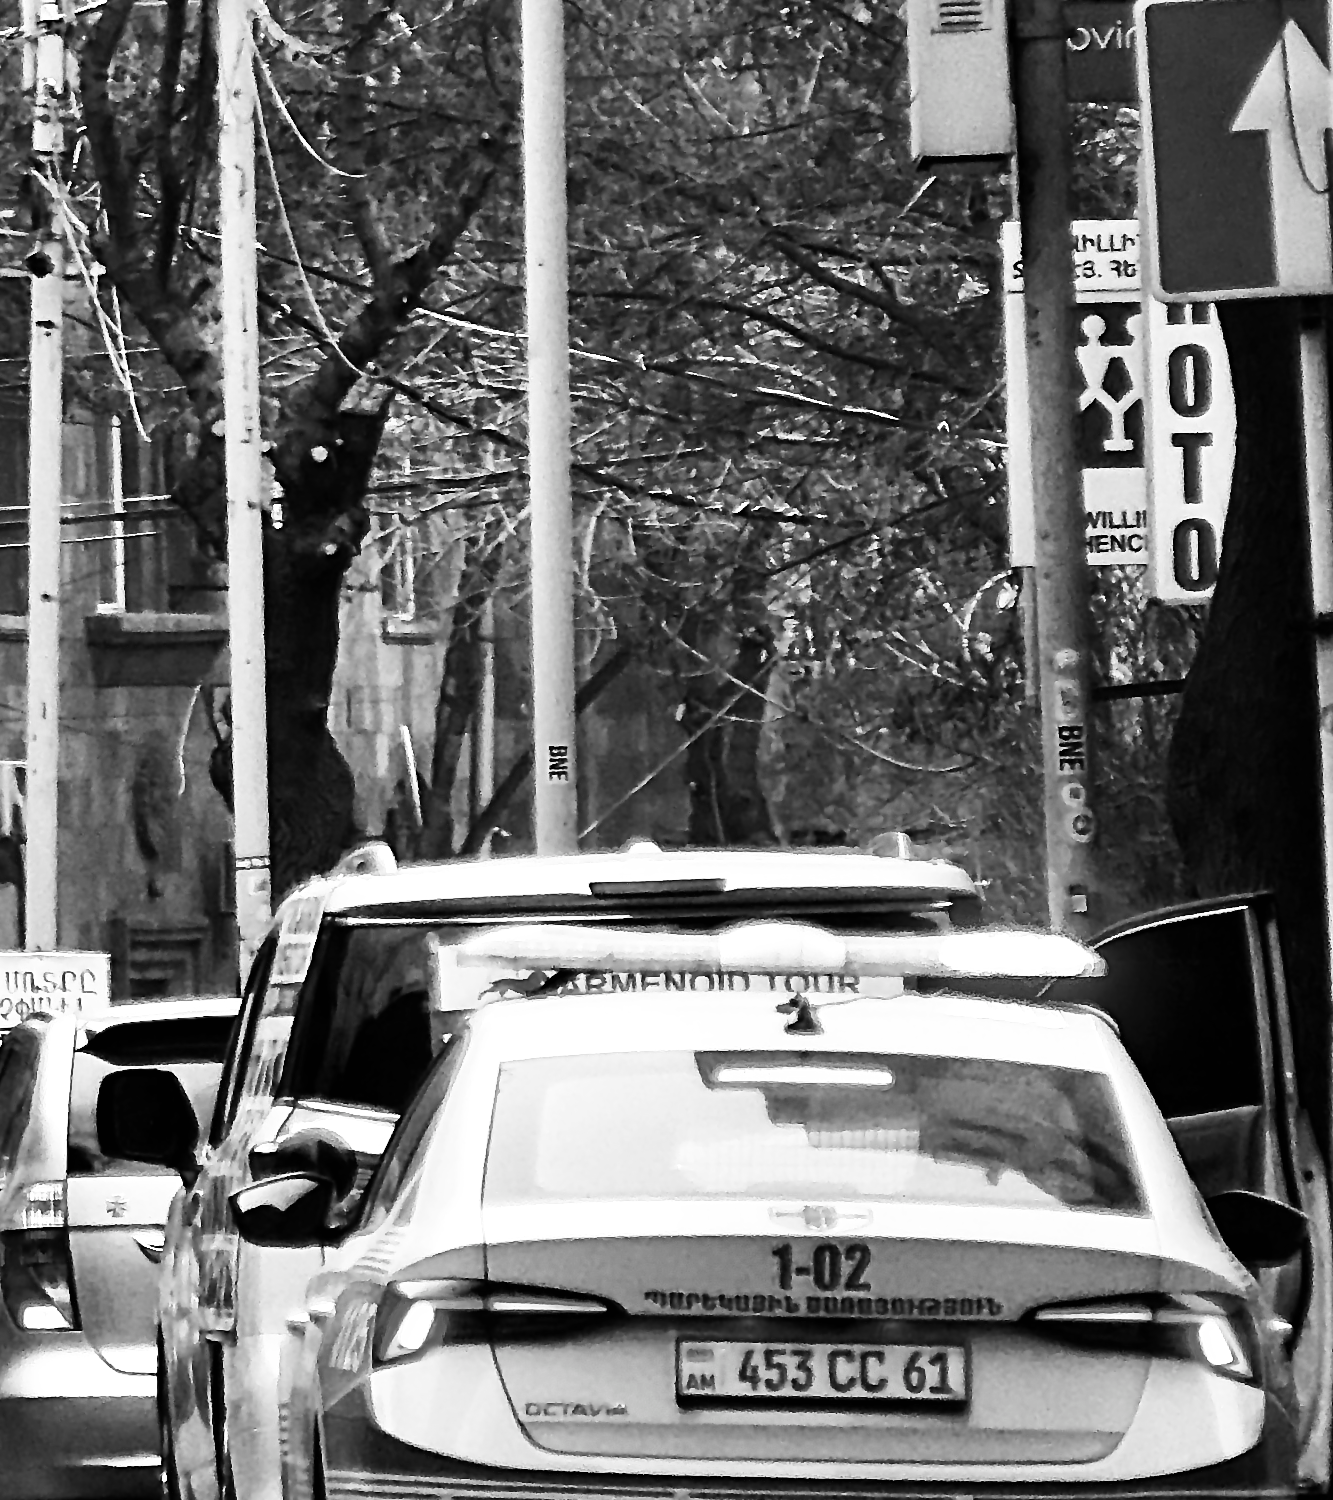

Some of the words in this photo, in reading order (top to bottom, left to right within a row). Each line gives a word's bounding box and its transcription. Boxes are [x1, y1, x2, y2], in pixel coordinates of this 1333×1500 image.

[1166, 302, 1220, 593] OTO
[548, 745, 569, 782] BNE
[1058, 725, 1084, 772] BNE
[765, 971, 860, 994] TOUR
[772, 1242, 872, 1292] 1-02
[685, 1373, 716, 1391] AM
[738, 1349, 815, 1392] 453
[827, 1349, 889, 1393] CC
[903, 1352, 955, 1395] 61
